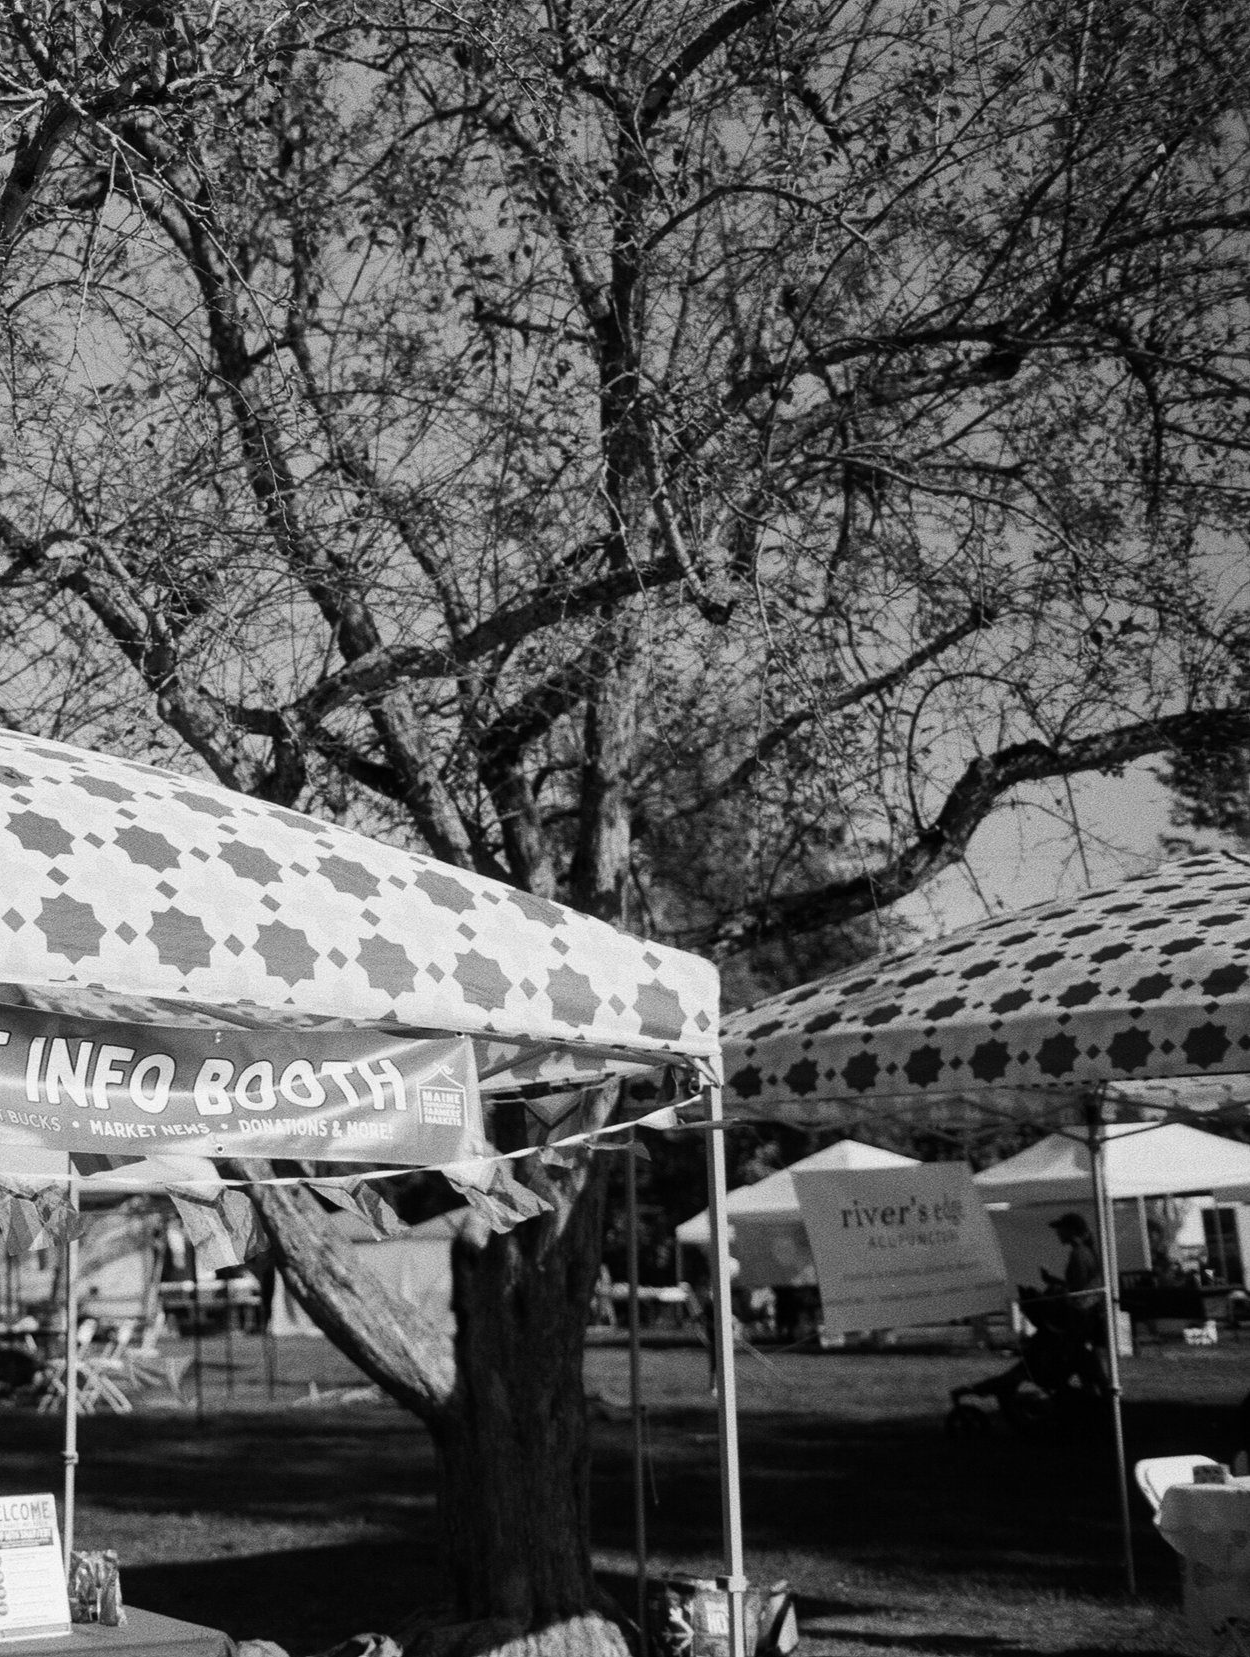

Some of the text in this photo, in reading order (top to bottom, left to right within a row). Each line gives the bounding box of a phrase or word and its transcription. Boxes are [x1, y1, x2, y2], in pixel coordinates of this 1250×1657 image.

[25, 1036, 177, 1114] INFO
[192, 1056, 409, 1116] BOOTH
[421, 1090, 461, 1105] MAINE
[7, 1107, 63, 1133] BUCKS
[90, 1118, 157, 1139] MARKET
[160, 1121, 211, 1137] NEWS
[238, 1118, 328, 1138] DONATIONS
[331, 1120, 344, 1138] &
[346, 1121, 394, 1140] MORE!
[424, 1114, 462, 1127] MARKETS
[840, 1195, 930, 1229] river's
